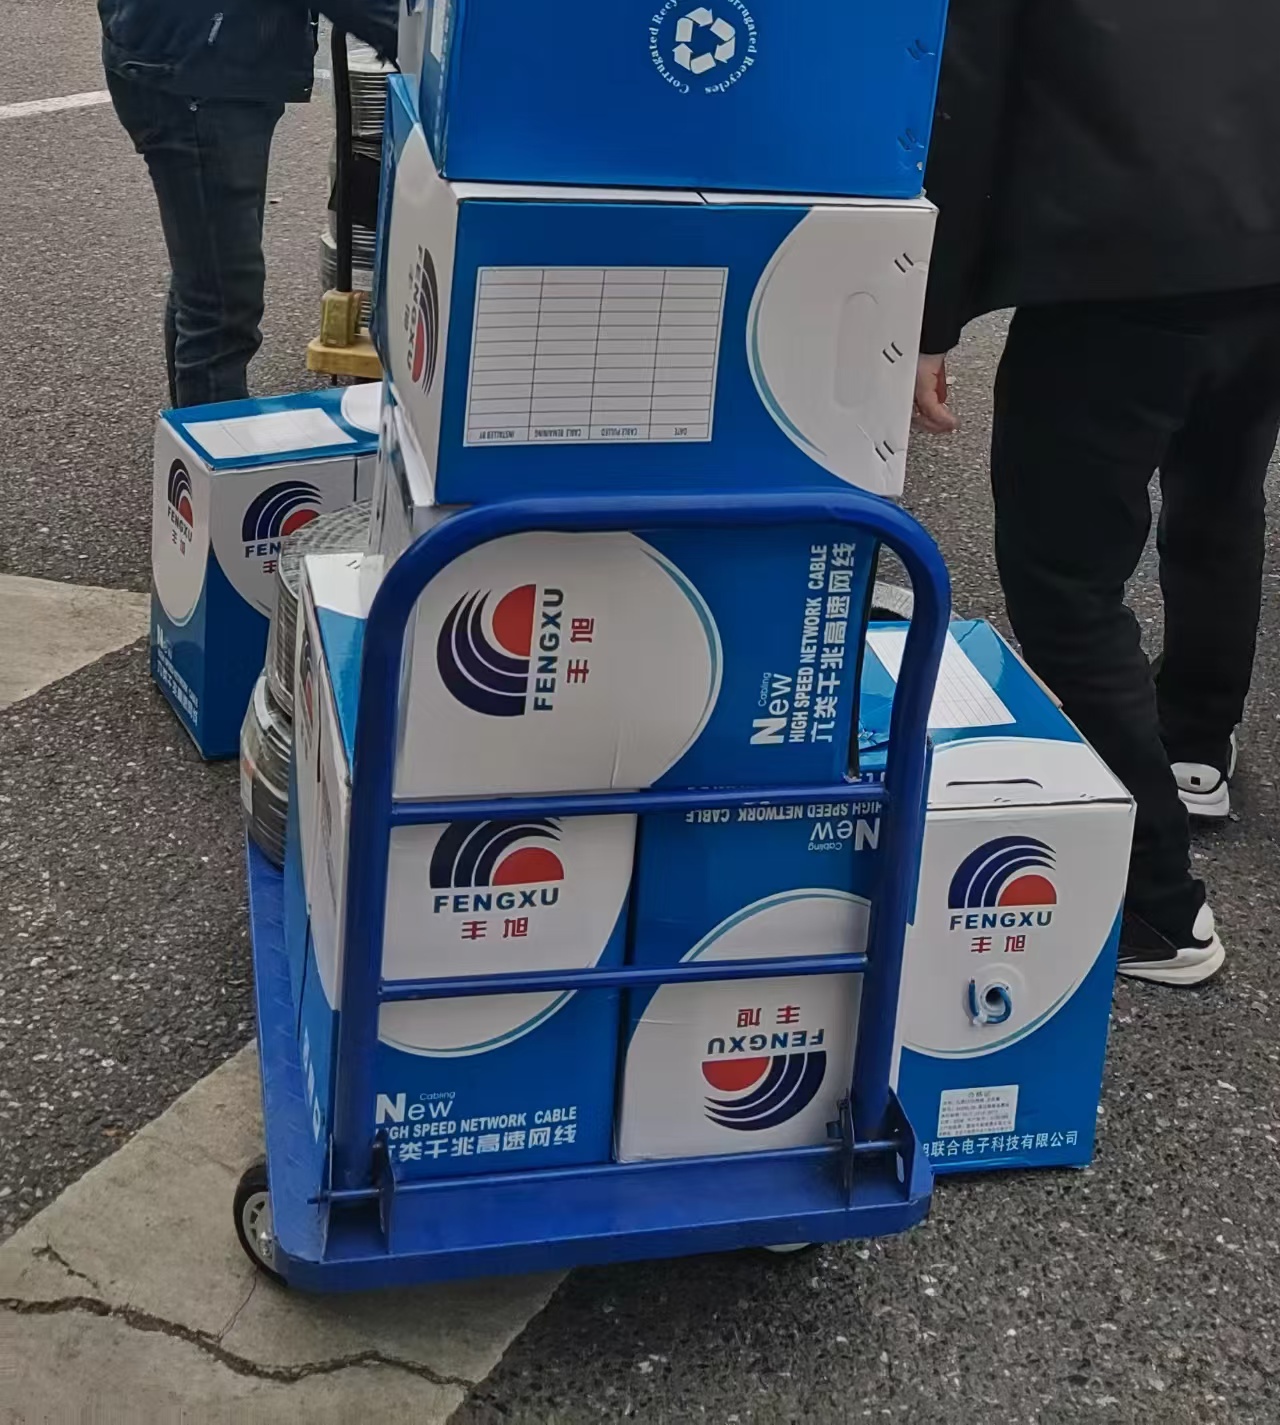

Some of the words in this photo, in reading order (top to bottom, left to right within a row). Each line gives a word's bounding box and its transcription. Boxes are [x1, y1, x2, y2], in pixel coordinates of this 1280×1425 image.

[648, 27, 690, 94] Corrugated
[704, 56, 755, 94] Recycles
[534, 429, 564, 438] REMAINING
[675, 427, 688, 436] DATE
[167, 505, 193, 543] FENGXU
[808, 544, 828, 590] CABLE
[800, 596, 822, 664] NETWORK
[810, 542, 857, 744] 六类千兆高速网线
[533, 588, 564, 711] FENGXU
[758, 672, 772, 708] Cabling
[793, 667, 814, 708] SPEED
[750, 673, 793, 745] New
[788, 711, 809, 744] HIGH
[737, 804, 804, 823] NETWORK
[807, 803, 849, 818] SPEED
[808, 842, 843, 851] Cabling
[810, 817, 881, 851] New
[433, 887, 559, 913] FENGXU
[949, 911, 1053, 930] FENGXU
[707, 1028, 825, 1055] FENGXU
[375, 1092, 454, 1125] New
[419, 1091, 456, 1101] Cabling
[413, 1120, 457, 1138] SPEED
[460, 1112, 527, 1133] NETWORK
[534, 1106, 577, 1124] CABLE
